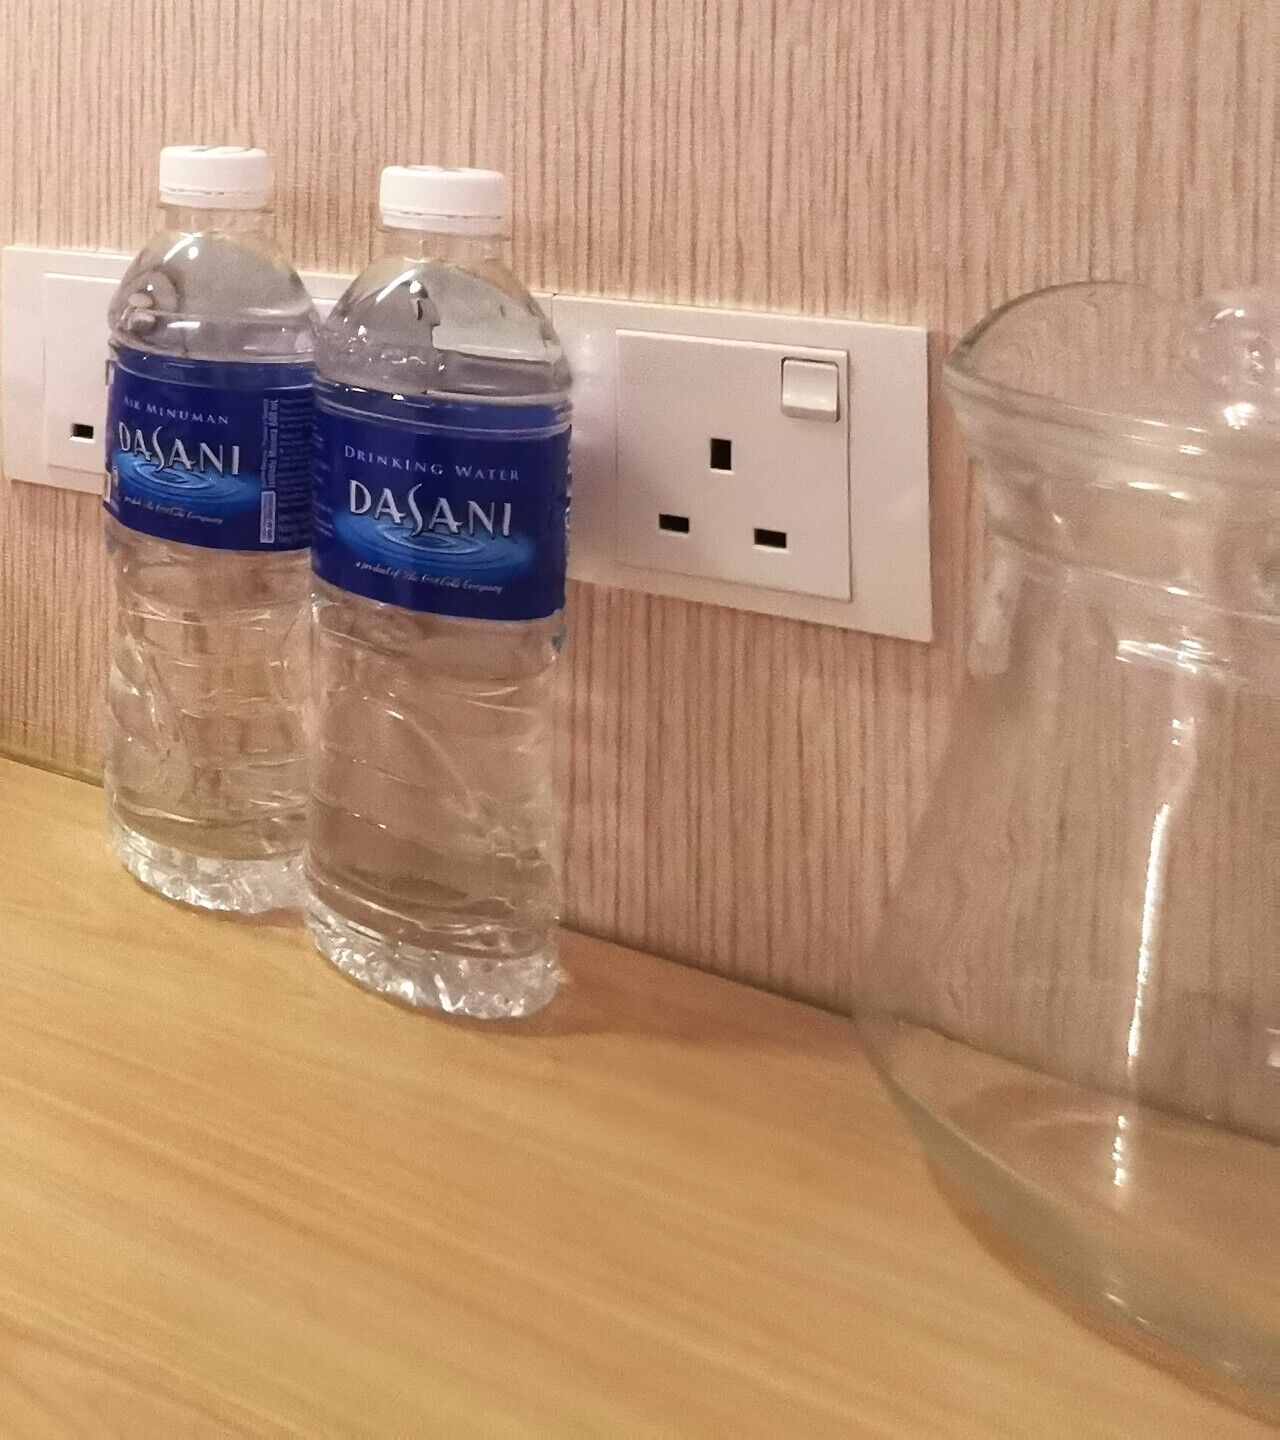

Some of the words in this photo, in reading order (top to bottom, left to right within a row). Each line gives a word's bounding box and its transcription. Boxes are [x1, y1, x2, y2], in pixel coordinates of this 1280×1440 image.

[146, 403, 230, 425] MINUMAN
[118, 420, 241, 477] DASANI
[344, 444, 444, 476] DRINKING
[454, 464, 520, 482] WATER
[348, 479, 513, 540] DASANI
